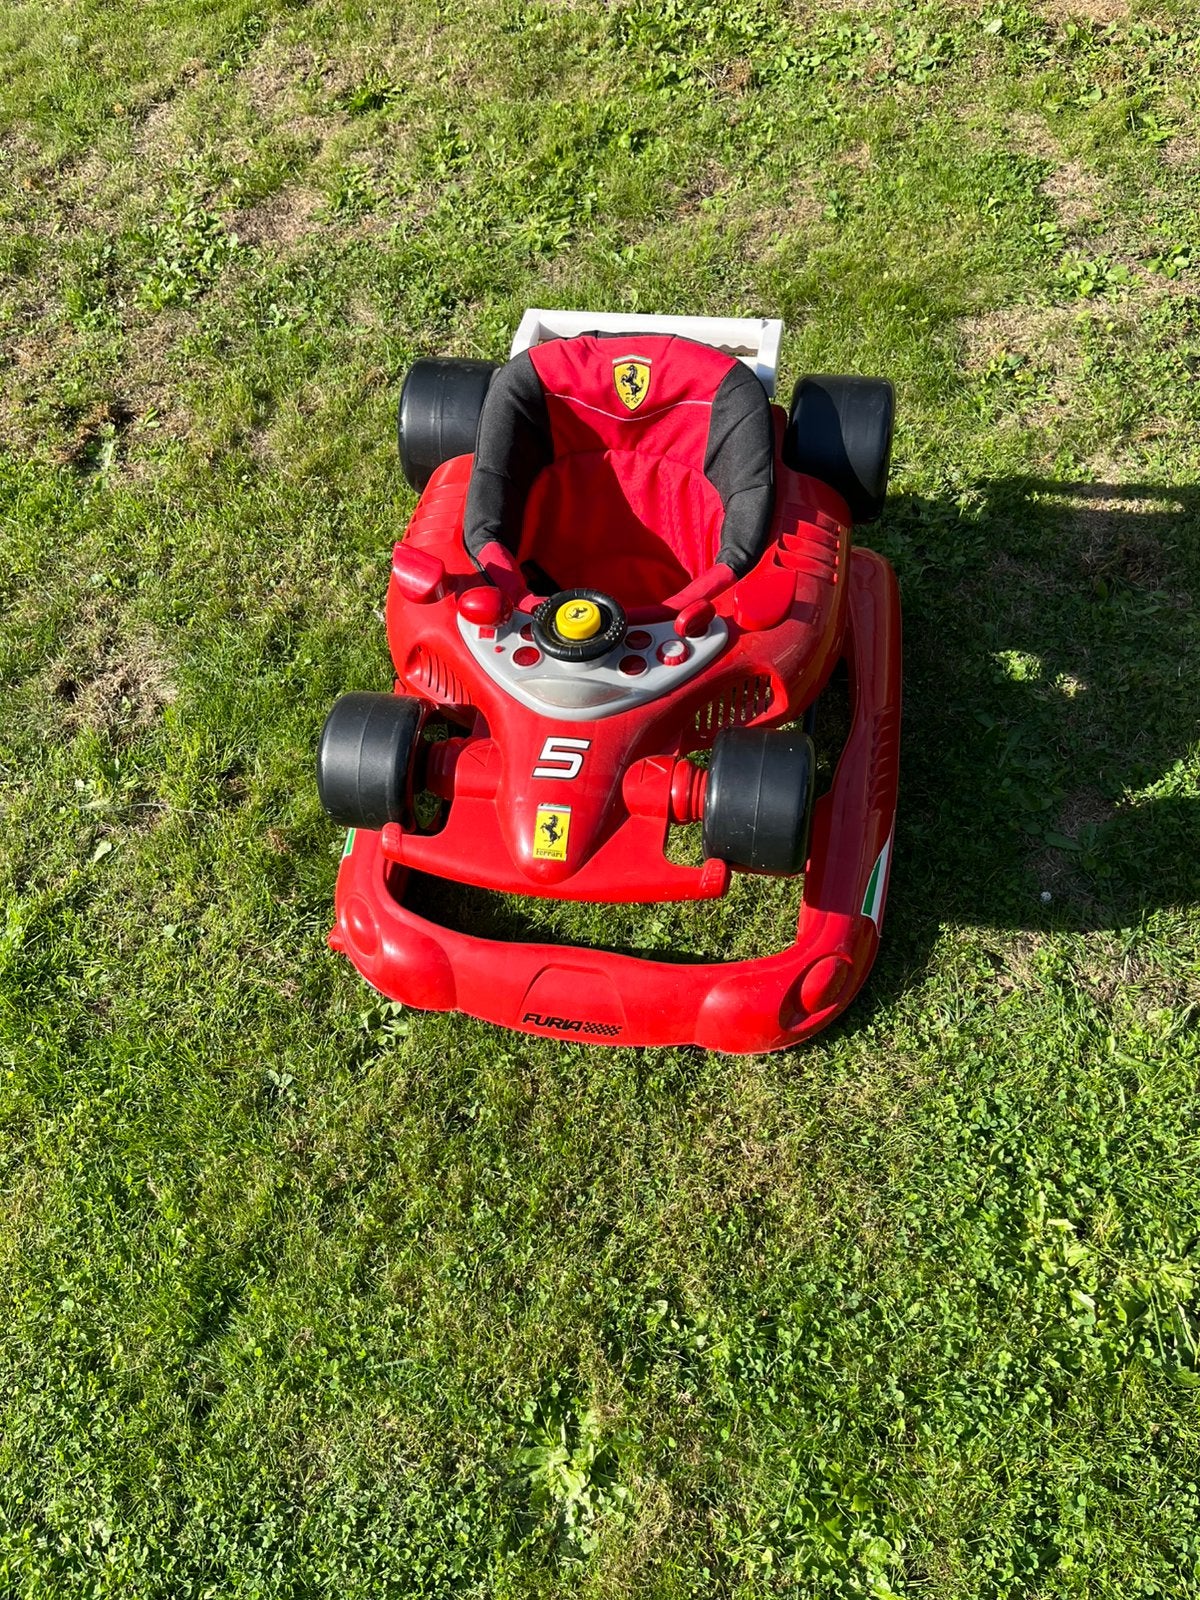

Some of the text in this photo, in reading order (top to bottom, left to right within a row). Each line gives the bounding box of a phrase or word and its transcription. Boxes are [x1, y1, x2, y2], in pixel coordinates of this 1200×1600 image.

[532, 736, 591, 779] 5
[535, 848, 563, 858] Ferrari
[522, 1012, 584, 1032] FURIA
